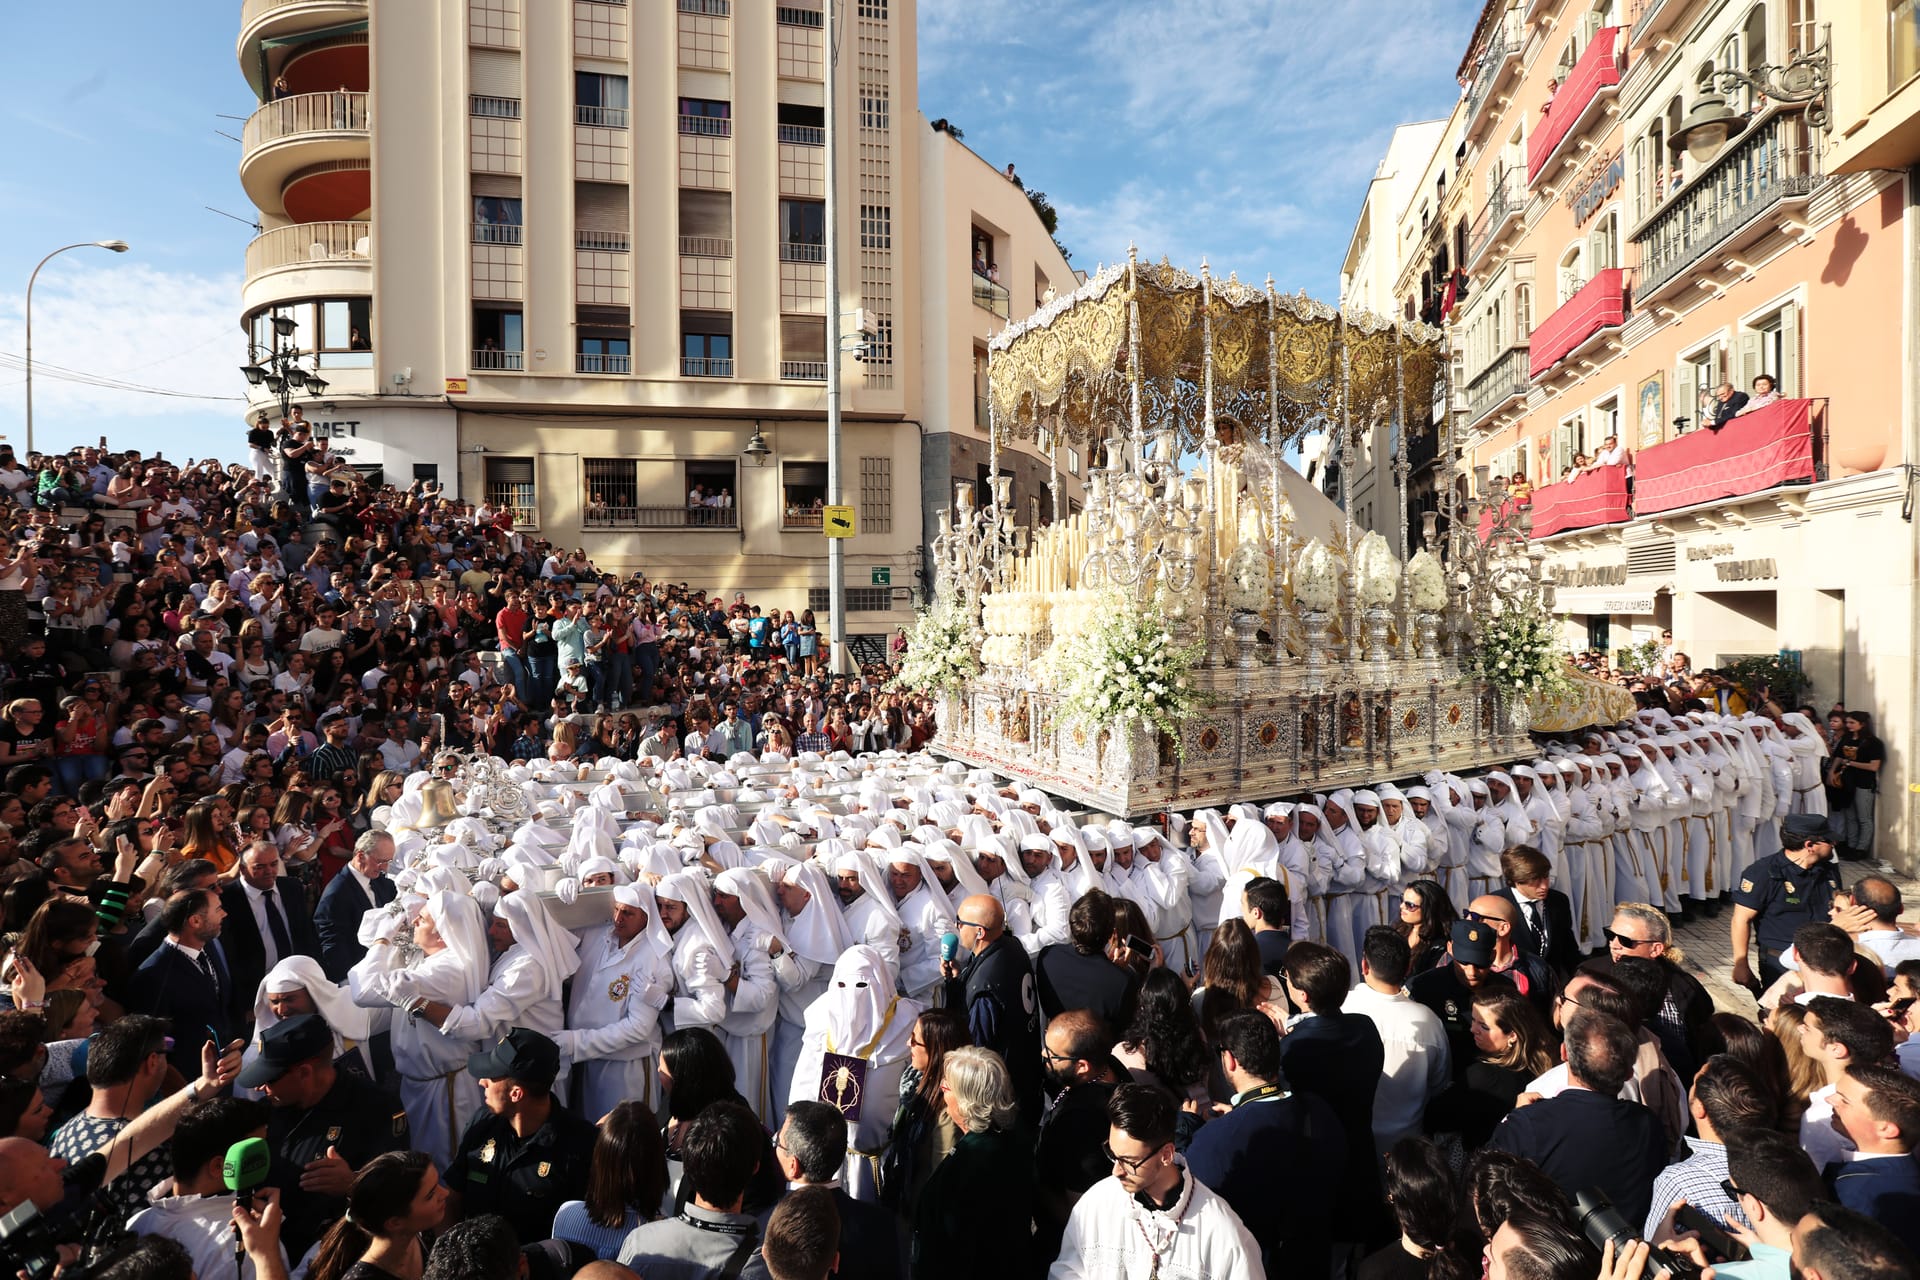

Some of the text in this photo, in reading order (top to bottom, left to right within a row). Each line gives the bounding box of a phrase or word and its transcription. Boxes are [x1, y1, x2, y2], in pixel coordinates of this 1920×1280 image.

[1573, 150, 1624, 226] TRIBUN
[313, 421, 361, 438] MET
[1714, 558, 1777, 581] TRIBUNA
